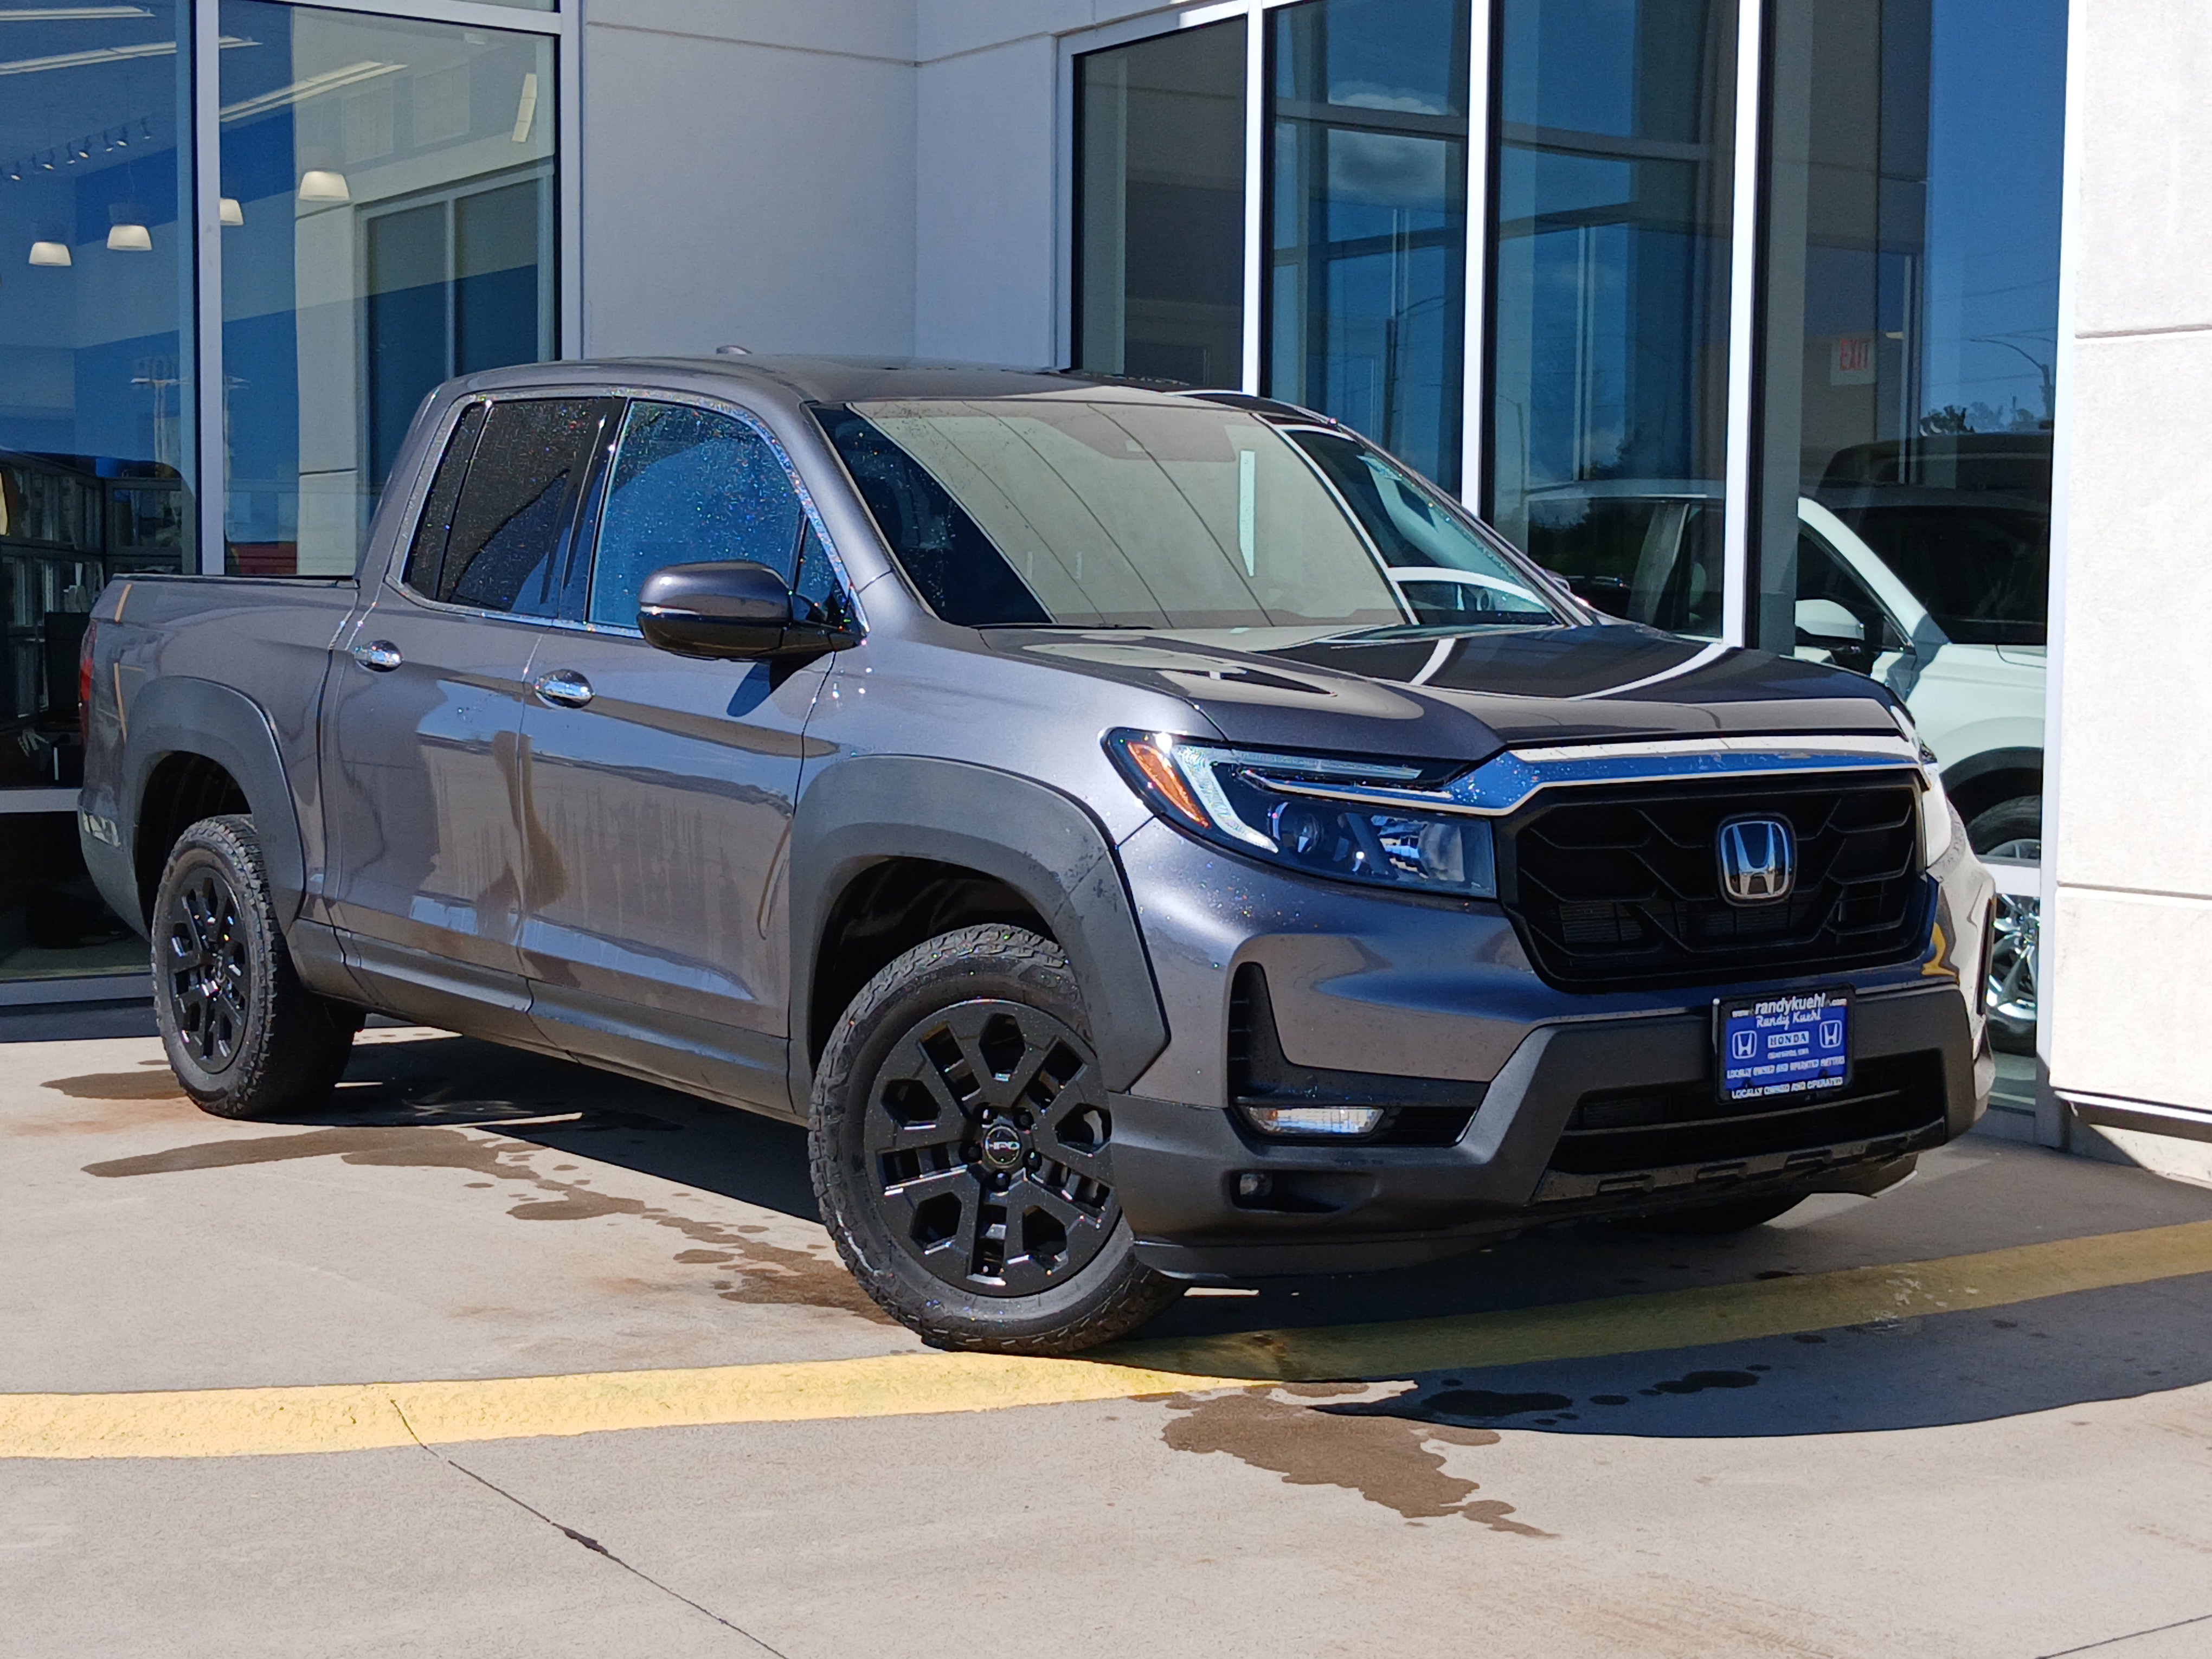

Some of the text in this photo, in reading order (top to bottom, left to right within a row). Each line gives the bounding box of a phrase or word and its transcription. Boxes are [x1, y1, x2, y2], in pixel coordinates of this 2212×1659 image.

[1839, 338, 1870, 371] EXIT
[1756, 1013, 1790, 1030] Randy
[1770, 1033, 1807, 1046] HONDA
